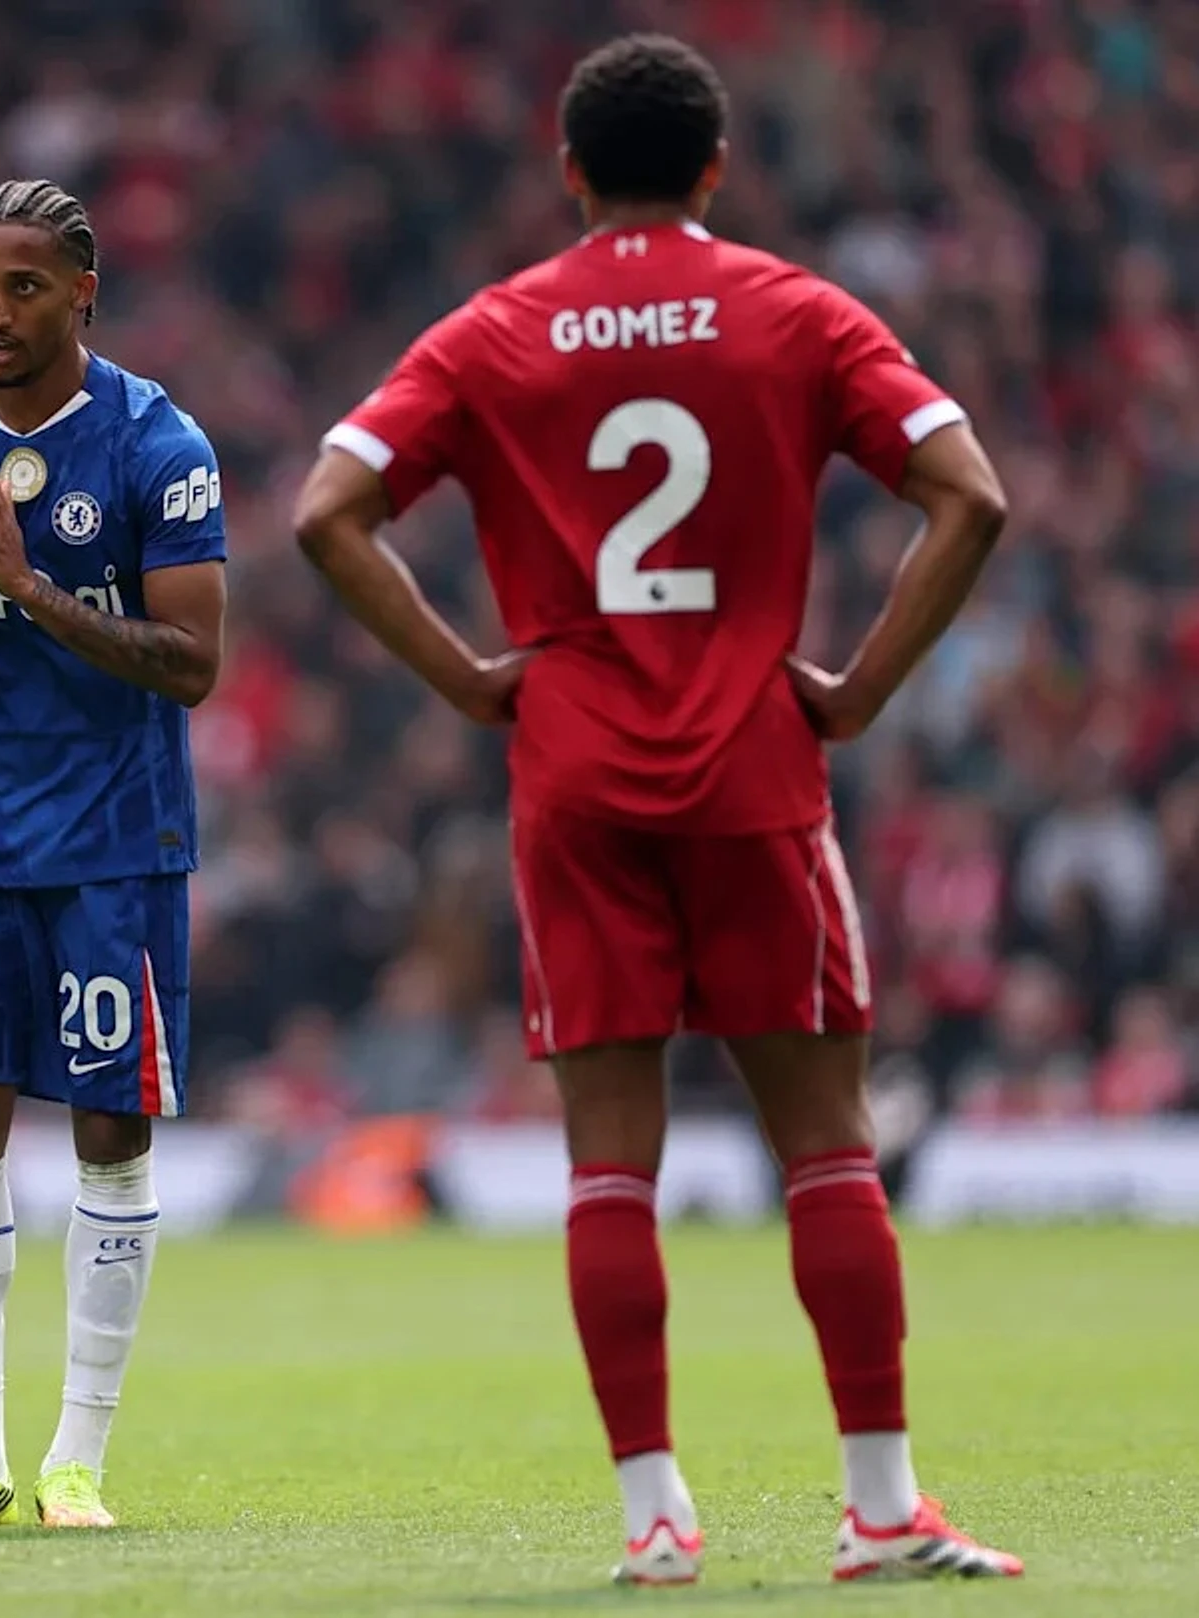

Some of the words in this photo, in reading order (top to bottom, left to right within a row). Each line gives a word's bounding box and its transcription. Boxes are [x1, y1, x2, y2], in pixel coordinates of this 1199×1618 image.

[550, 298, 719, 353] GOMEZ
[587, 398, 717, 615] 2
[58, 971, 133, 1051] 20
[99, 1237, 142, 1251] CFC
